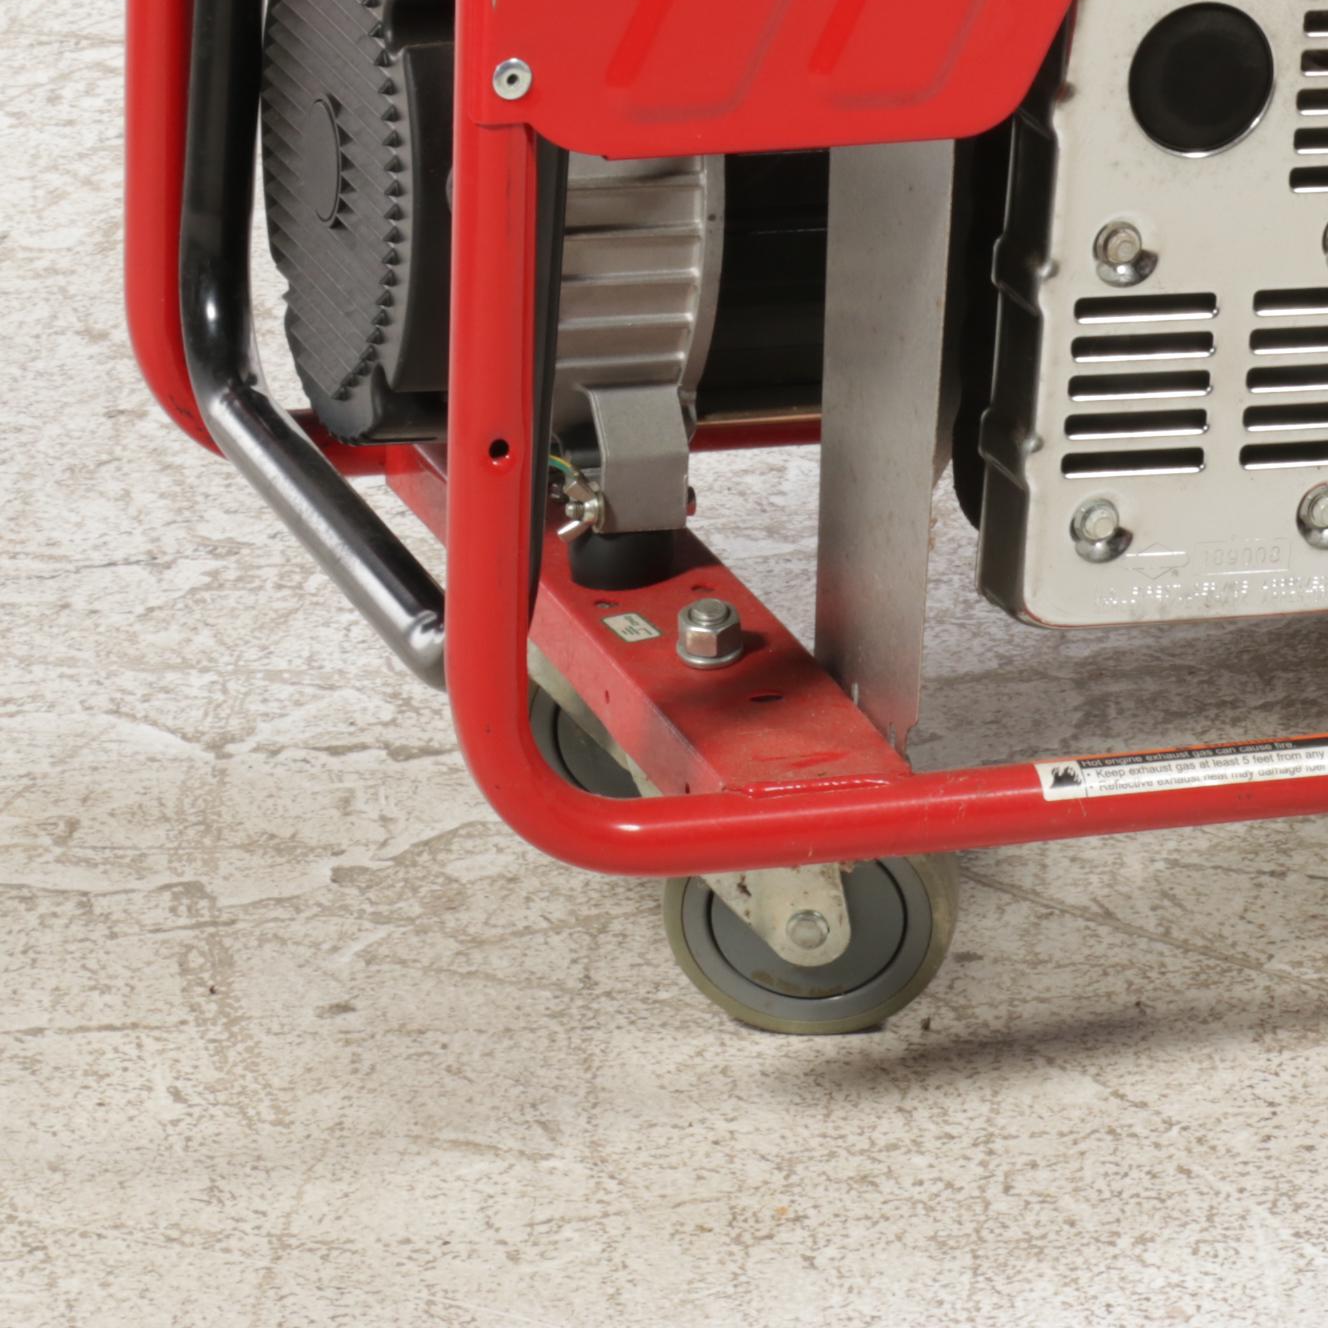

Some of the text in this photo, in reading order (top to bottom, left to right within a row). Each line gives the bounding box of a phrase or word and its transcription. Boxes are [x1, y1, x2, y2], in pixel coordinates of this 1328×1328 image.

[1081, 759, 1103, 768] Hot
[1104, 755, 1143, 766] engine
[1145, 750, 1190, 762] exhaust
[1191, 749, 1213, 758] gas
[1215, 746, 1235, 755] can
[1238, 743, 1272, 753] cause
[1096, 768, 1126, 779] Keep
[1128, 763, 1173, 775] exhaust
[1175, 762, 1195, 773] gas
[1199, 760, 1210, 769] at
[1212, 757, 1240, 768] least
[1242, 756, 1250, 765] 5
[1252, 753, 1274, 764] feet
[1276, 751, 1302, 762] from
[1304, 749, 1325, 761] any
